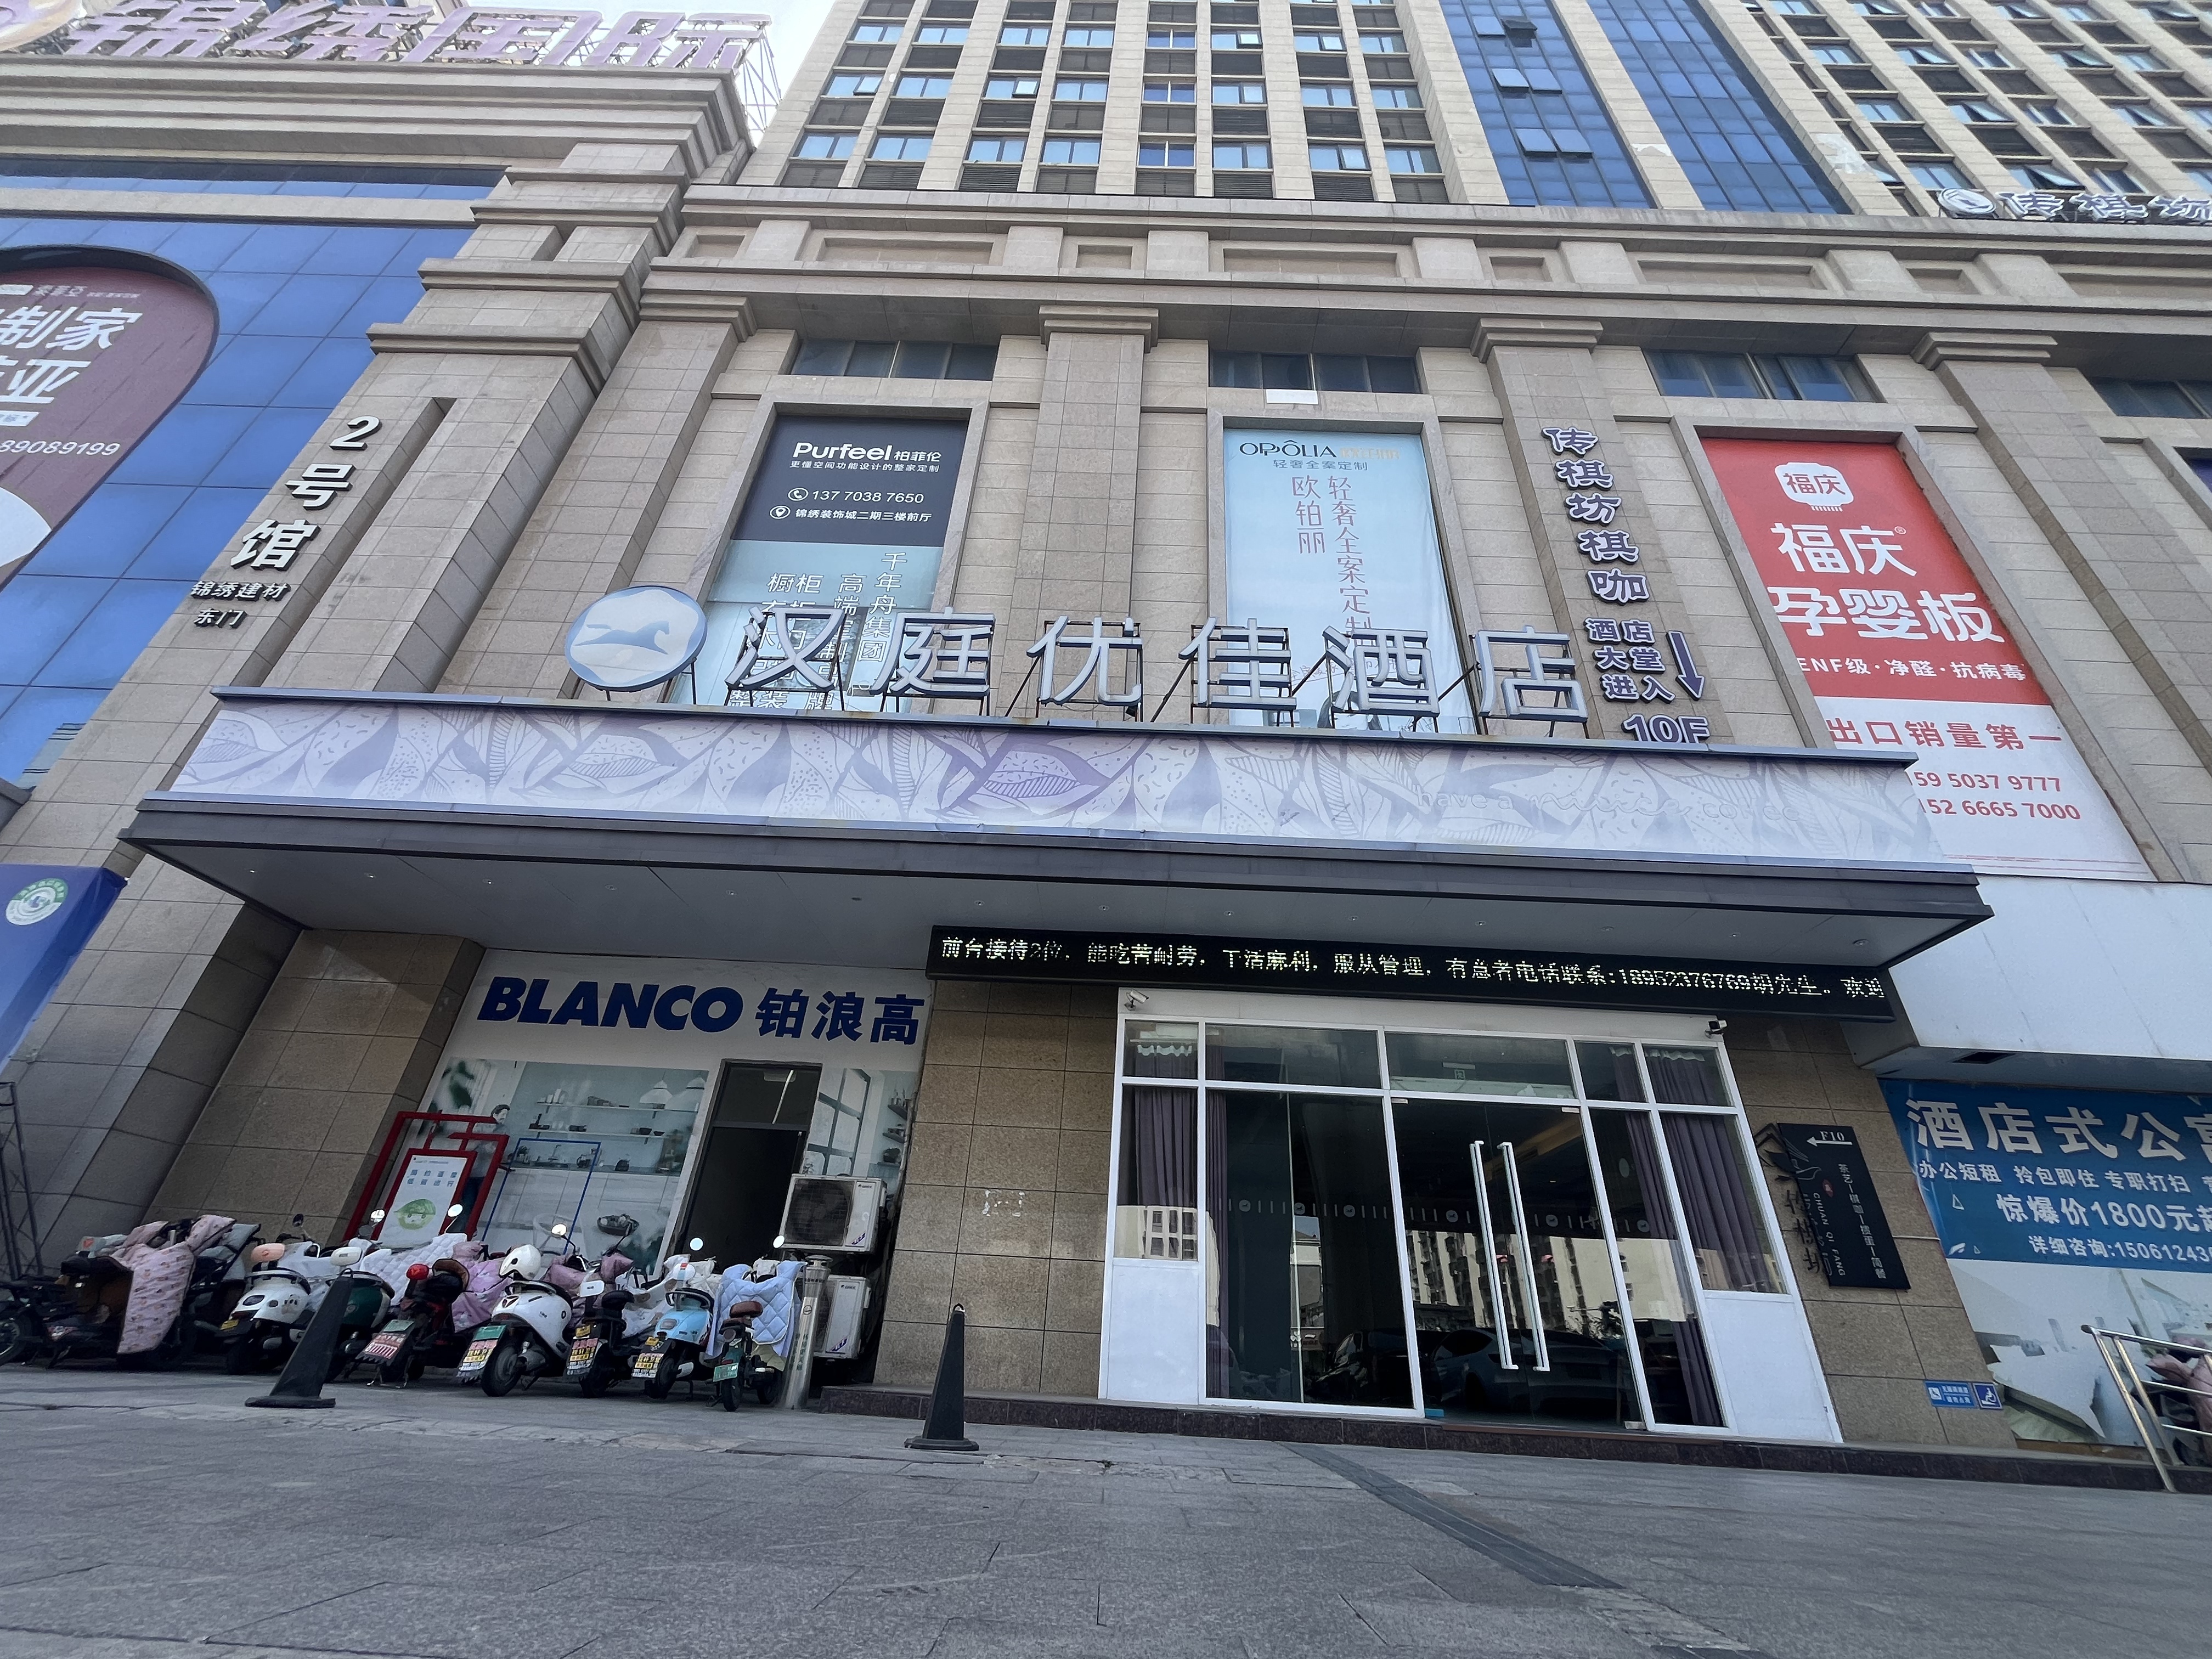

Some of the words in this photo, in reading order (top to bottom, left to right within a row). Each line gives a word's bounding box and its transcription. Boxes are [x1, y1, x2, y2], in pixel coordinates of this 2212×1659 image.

[0, 305, 143, 351] 制家
[792, 442, 893, 461] Purfeel
[894, 450, 942, 462] 柏菲伦
[789, 460, 940, 473] 更懂空间功能设计的整家定制
[1273, 459, 1368, 472] 轻奢全案定制
[812, 490, 840, 500] 137
[844, 491, 882, 502] 7038
[886, 493, 924, 503] 7650
[1783, 472, 1848, 497] 福庆
[795, 509, 932, 522] 锦绣装饰城二期三楼前厅
[1290, 476, 1326, 555] 欧铂丽
[190, 580, 291, 602] 锦绣建材
[766, 572, 825, 595] 橱柜
[194, 608, 247, 629] 东门
[857, 552, 907, 663] 千年舟集团
[1767, 586, 2005, 643] 孕婴板
[1584, 617, 1656, 644] 酒店
[724, 606, 1588, 723] 汉庭优佳酒店
[1594, 645, 1666, 672] 大堂
[1600, 674, 1674, 703] 进入
[1622, 714, 1710, 743] 10F
[1947, 772, 2000, 789] 5037
[2007, 775, 2061, 792] 9777
[1962, 800, 2018, 817] 6665
[2021, 802, 2081, 820] 7000
[477, 975, 744, 1034] BLANCO
[755, 986, 926, 1045] 铂浪高
[1819, 1130, 1845, 1142] F10
[1918, 1159, 2002, 1184] 办公短租
[2014, 1164, 2101, 1188] 拎包即住
[2104, 1170, 2192, 1193] 专职打扫
[1813, 1192, 1831, 1226] CHUAN
[1831, 1249, 1846, 1277] FANG
